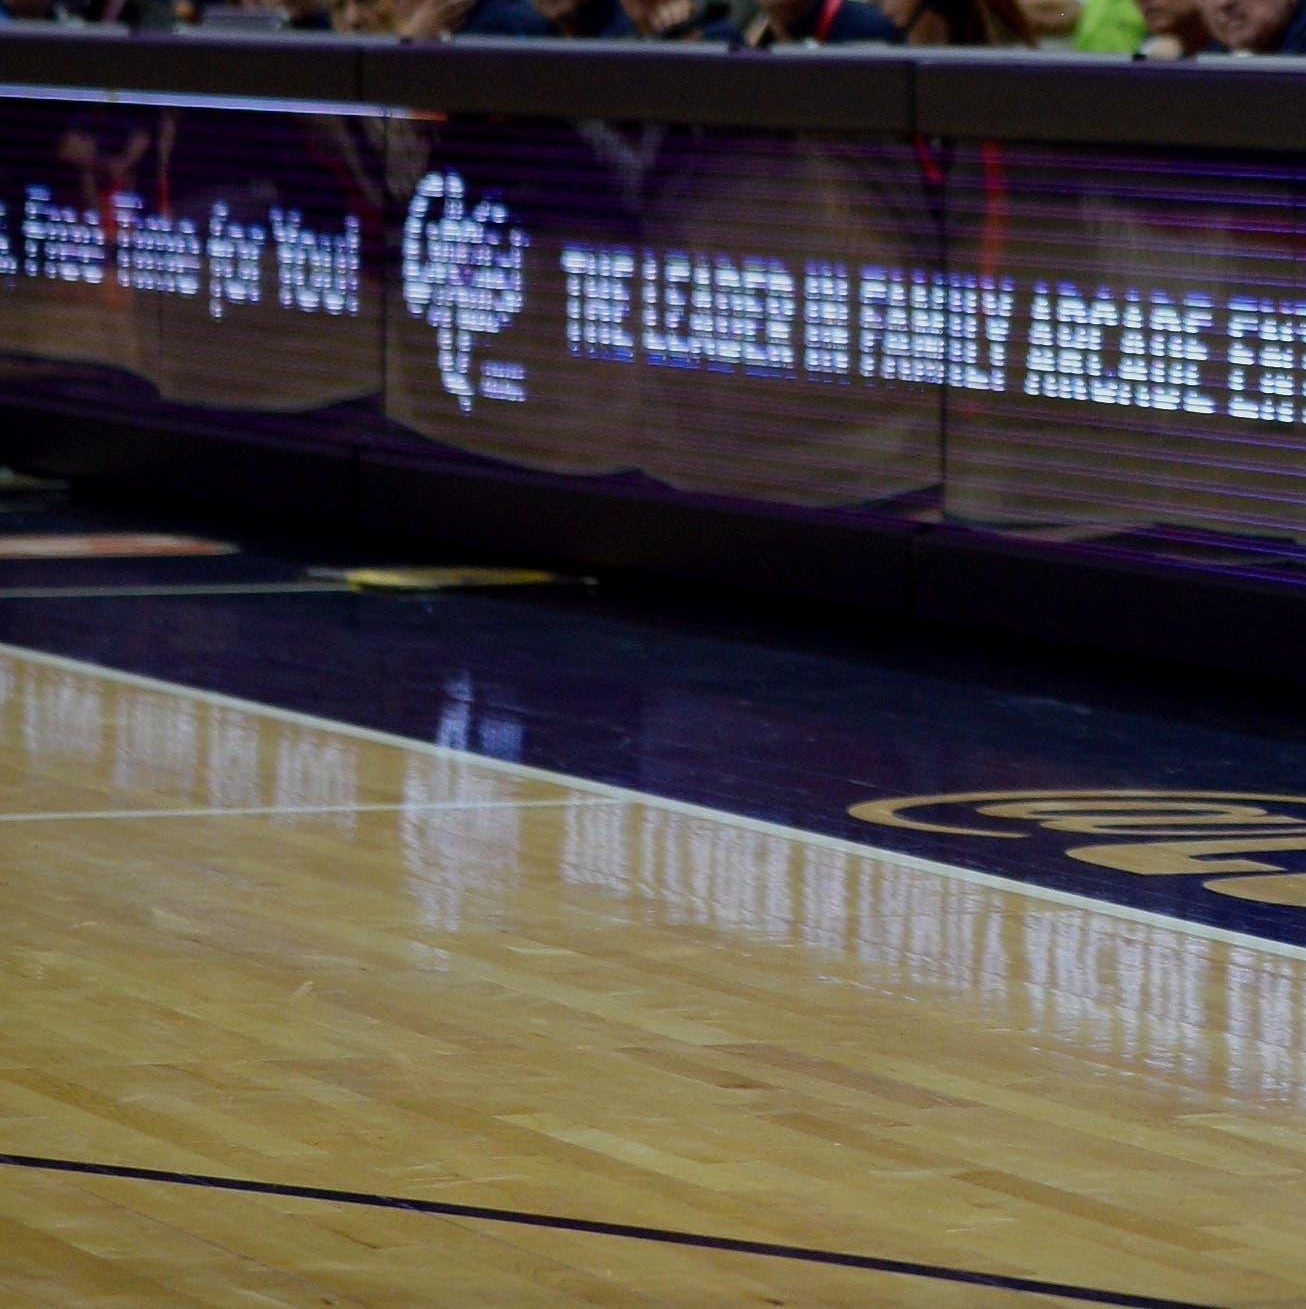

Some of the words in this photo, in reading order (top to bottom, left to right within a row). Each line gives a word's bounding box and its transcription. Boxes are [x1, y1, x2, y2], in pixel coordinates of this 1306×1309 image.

[560, 239, 636, 363] THE
[641, 245, 797, 381] LEADER
[803, 256, 850, 385] IN
[858, 263, 1015, 395] FAMILY
[1022, 276, 1216, 415] ARCADE
